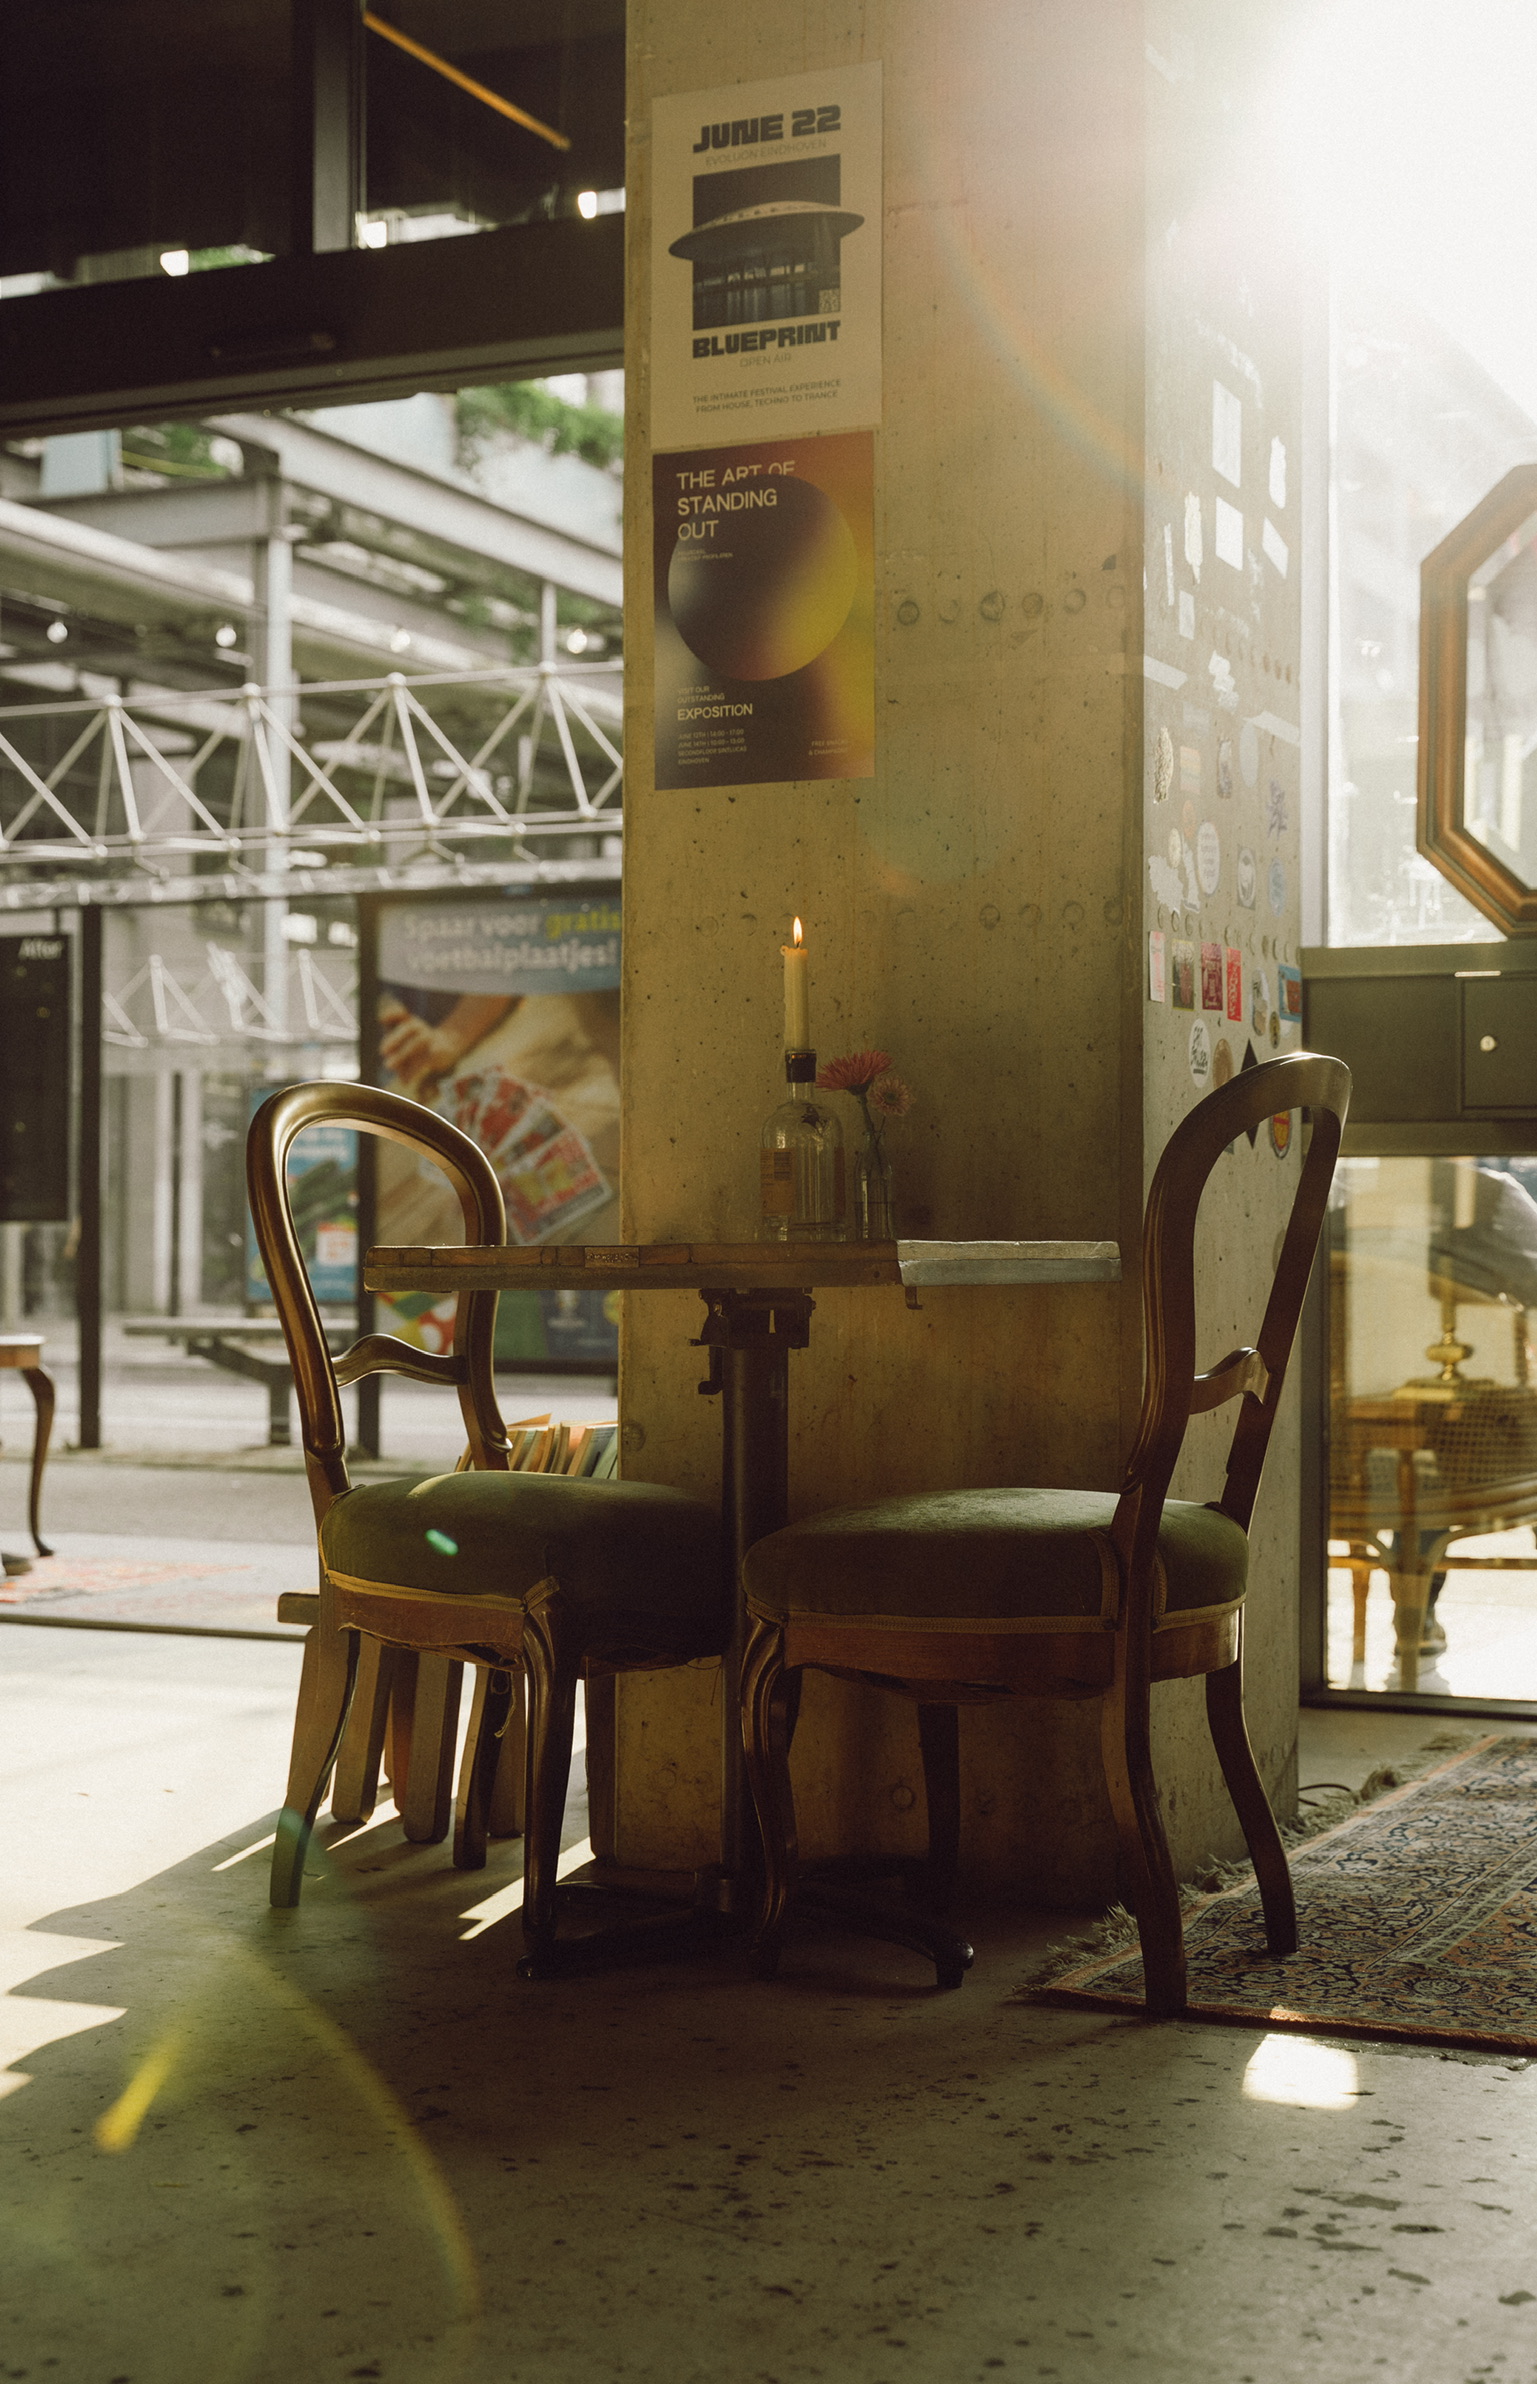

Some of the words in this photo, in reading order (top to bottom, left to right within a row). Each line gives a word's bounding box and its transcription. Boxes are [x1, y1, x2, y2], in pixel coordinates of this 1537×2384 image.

[693, 113, 784, 154] JUNE
[791, 104, 841, 138] 22
[760, 138, 827, 157] EINDHOVEN
[692, 320, 841, 359] BLUEPRINT
[739, 355, 771, 367] OPEN
[774, 352, 792, 363] AIR
[693, 395, 709, 404] THE
[710, 389, 748, 401] INTIMATE
[750, 386, 787, 397] FESTIVAL
[789, 378, 841, 392] EXPERIENCE
[696, 404, 720, 413] FROM
[755, 396, 789, 406] TECHNO
[791, 394, 803, 402] TO
[804, 389, 838, 401] TRANCE
[676, 469, 716, 490] THE
[721, 464, 763, 486] ART
[768, 460, 796, 476] OF
[677, 488, 778, 516] STANDING
[677, 520, 719, 541] OUT
[677, 692, 726, 704] OUTSTANDING
[695, 685, 710, 693] OUR
[677, 703, 753, 721] EXPOSITION
